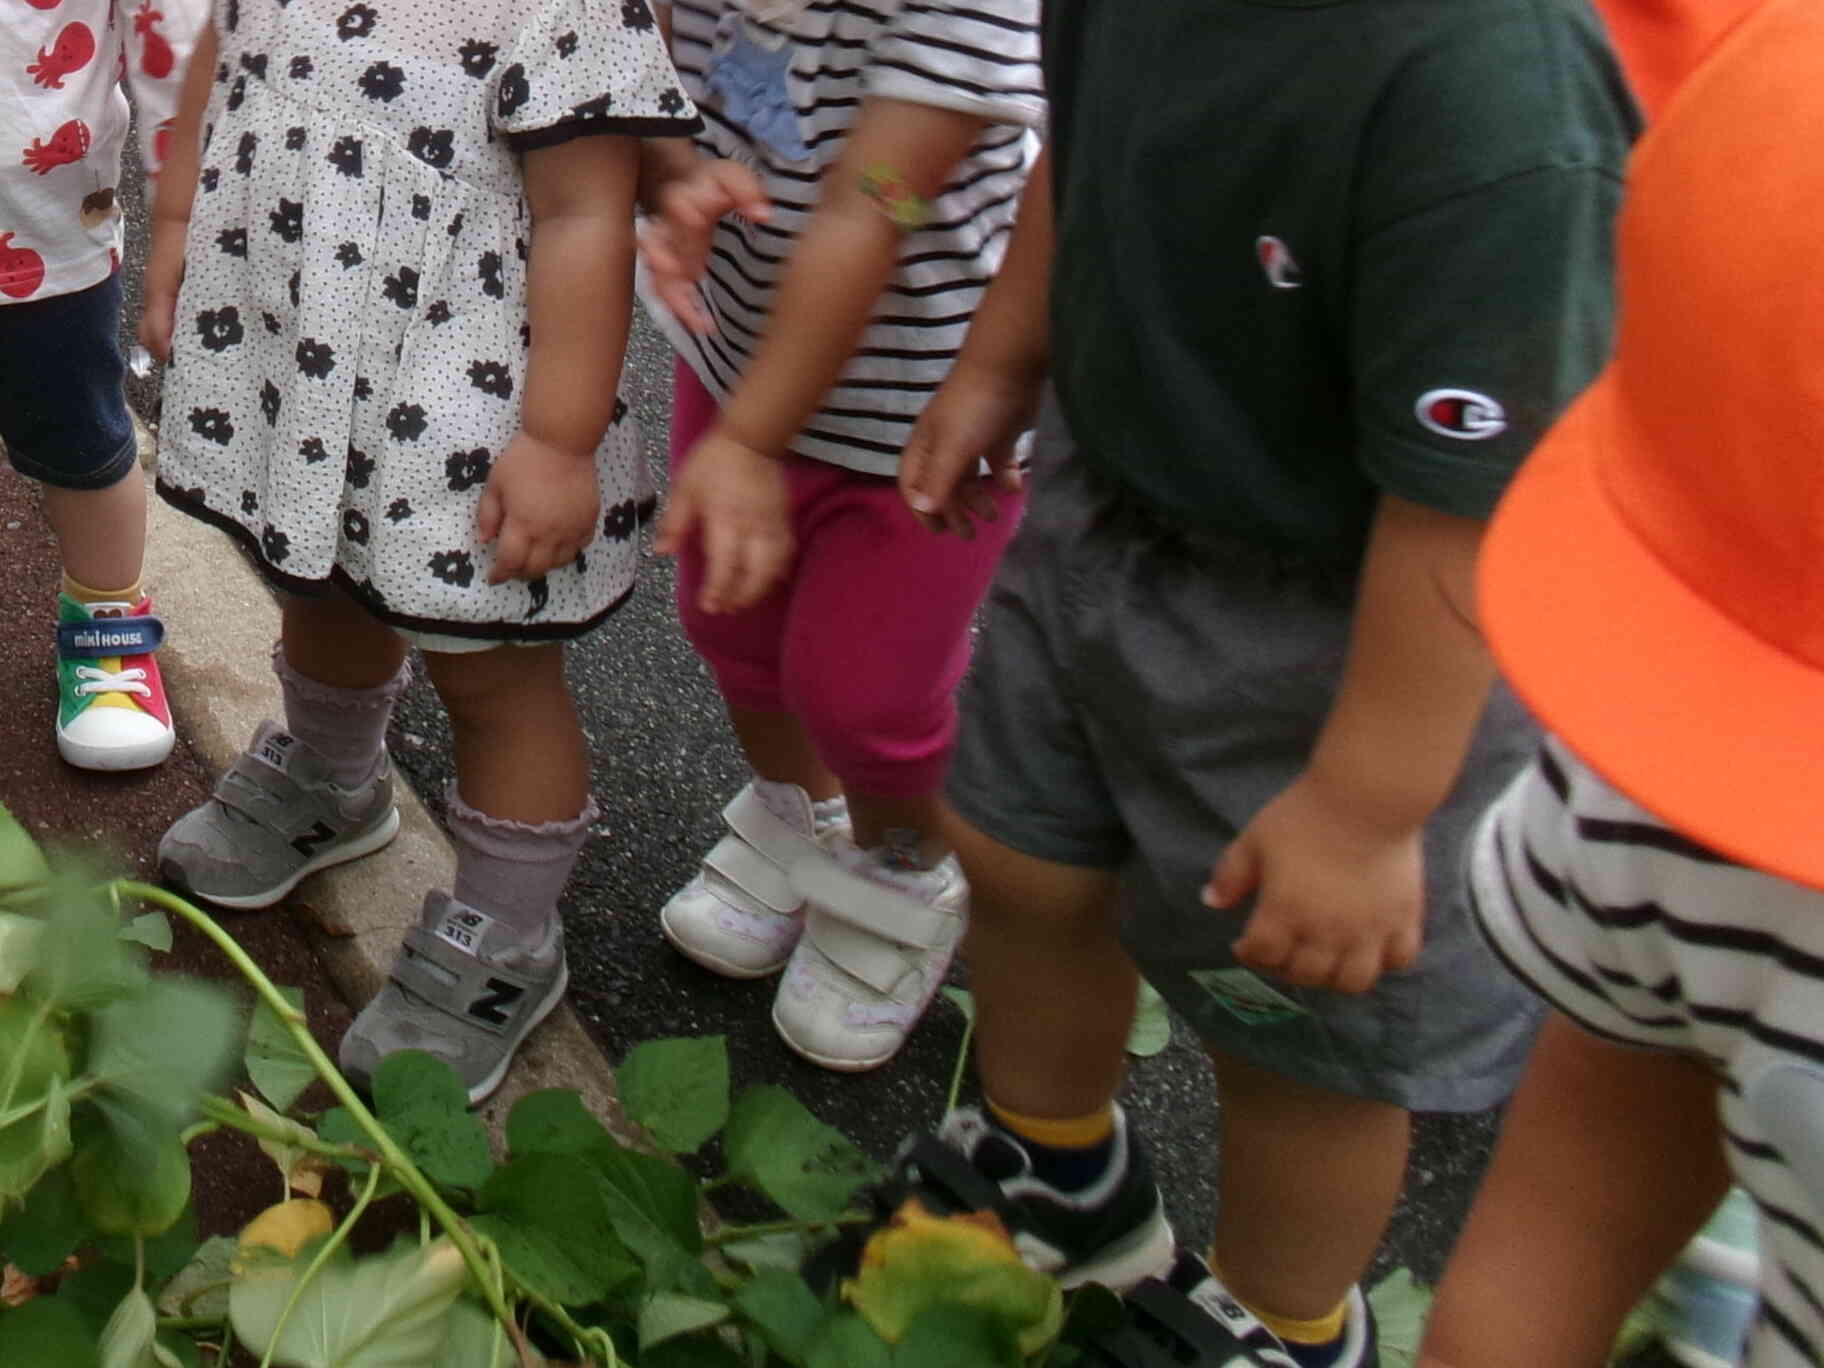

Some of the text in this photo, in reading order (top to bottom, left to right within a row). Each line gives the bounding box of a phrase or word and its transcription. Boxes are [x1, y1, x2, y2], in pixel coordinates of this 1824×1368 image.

[261, 746, 284, 766] 313
[290, 821, 338, 858] N
[443, 925, 473, 947] 313
[468, 977, 525, 1025] N
